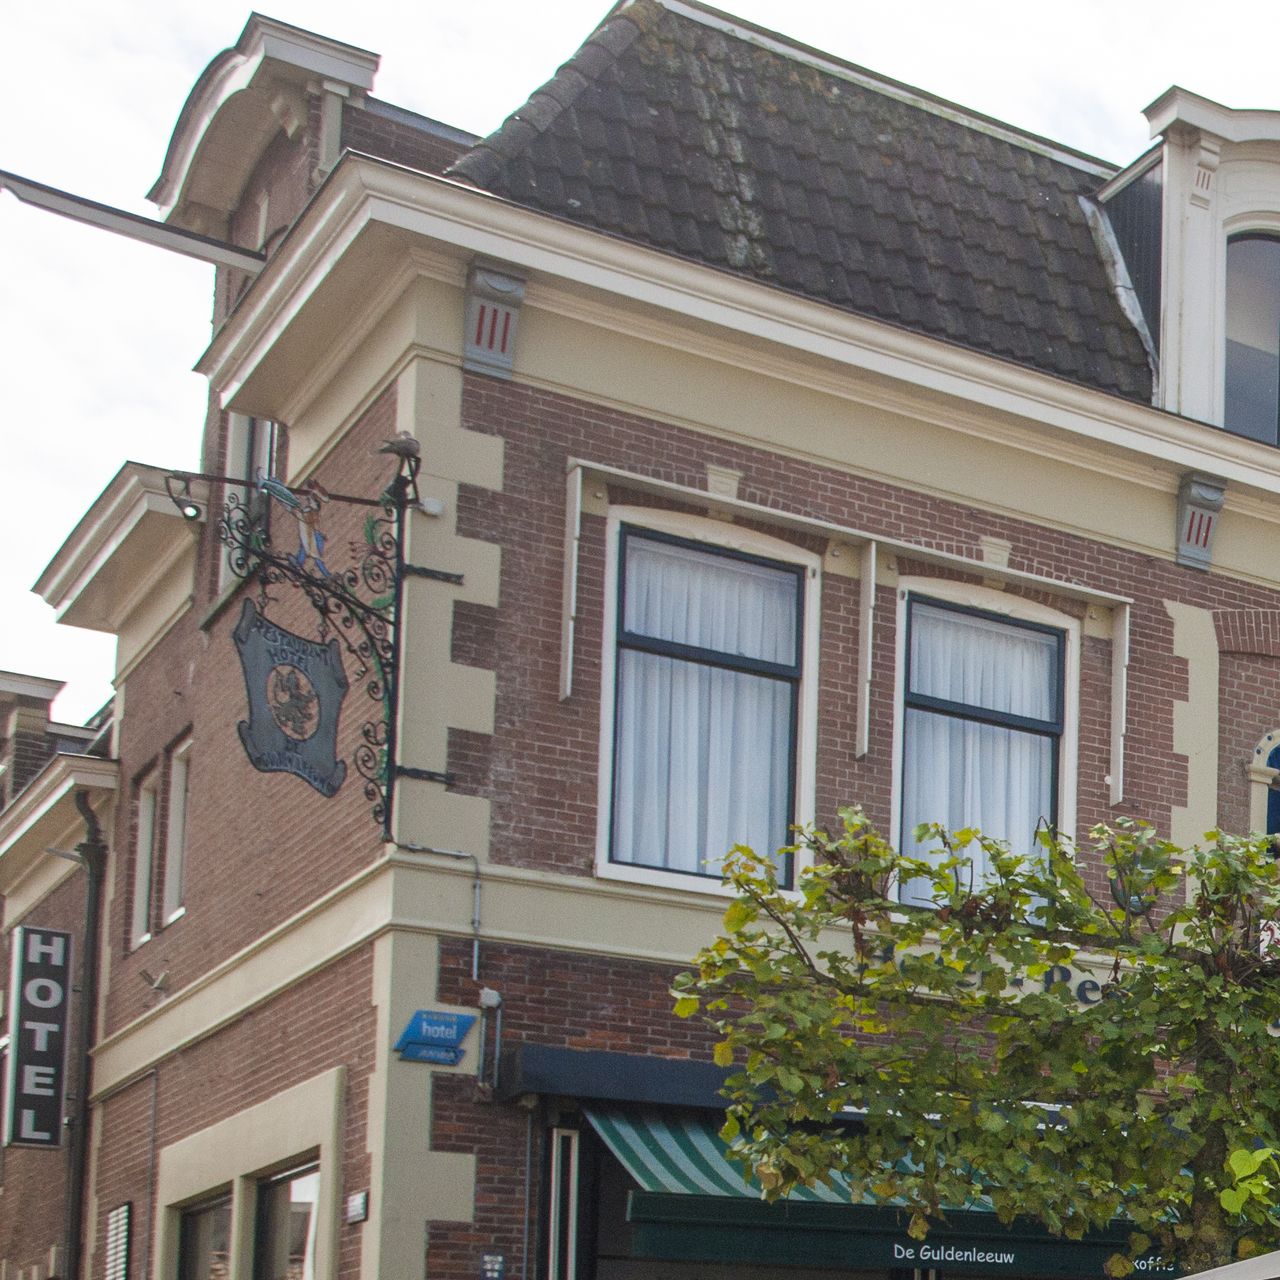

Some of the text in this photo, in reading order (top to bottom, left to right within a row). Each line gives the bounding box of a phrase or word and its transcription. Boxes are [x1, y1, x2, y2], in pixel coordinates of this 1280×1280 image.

[20, 933, 65, 1140] HOTEL
[422, 1022, 457, 1039] hotel
[893, 1243, 1015, 1264] De Guldenleeuw
